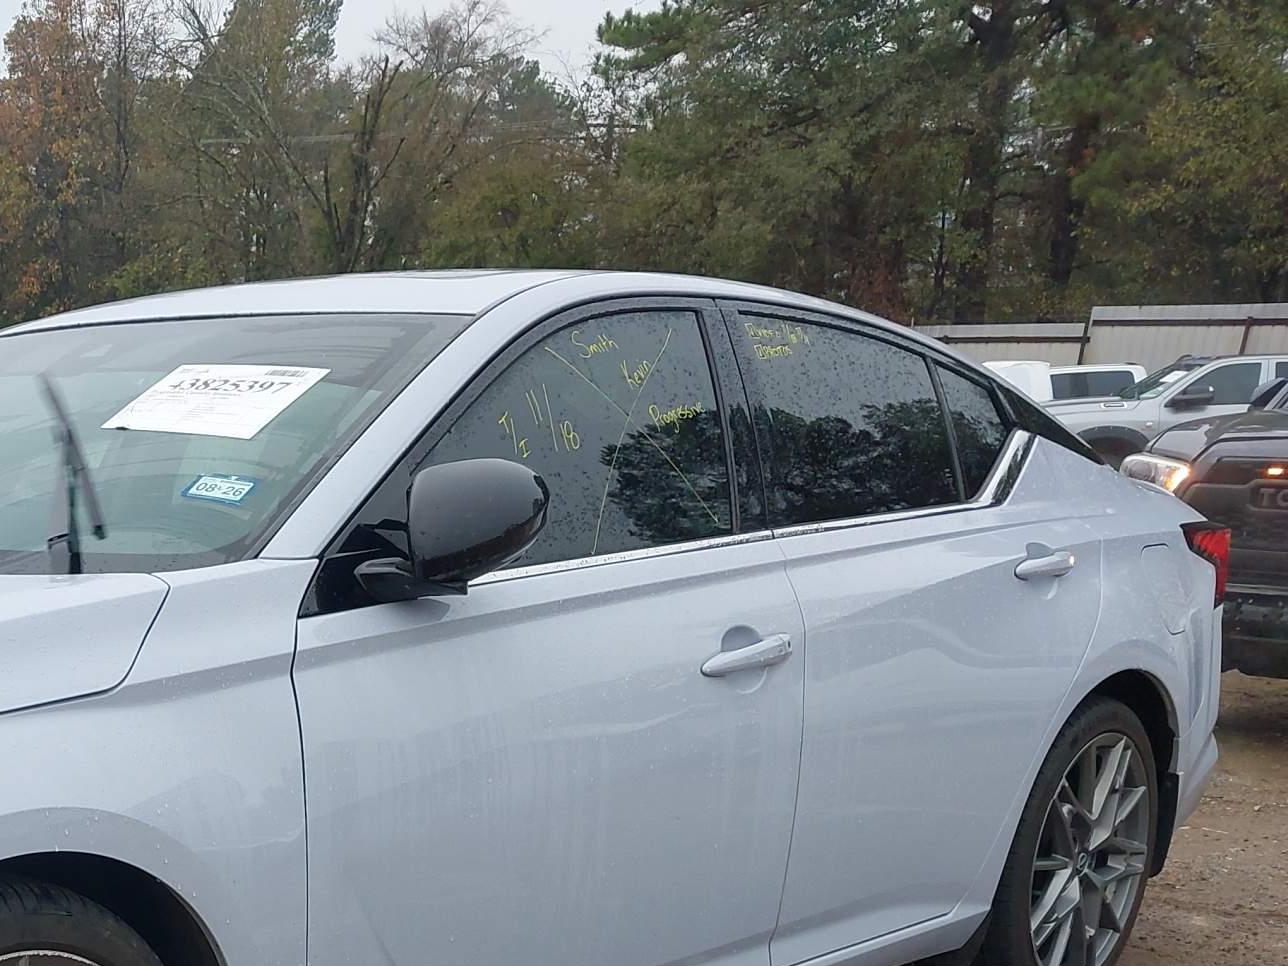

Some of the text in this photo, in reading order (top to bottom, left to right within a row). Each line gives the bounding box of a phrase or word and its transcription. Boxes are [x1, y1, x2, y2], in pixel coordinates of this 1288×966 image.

[571, 330, 620, 359] Smith
[168, 377, 293, 394] 43825397
[620, 359, 652, 390] Kevin
[648, 401, 707, 433] Progressive
[195, 482, 218, 493] 08
[221, 485, 246, 497] 26
